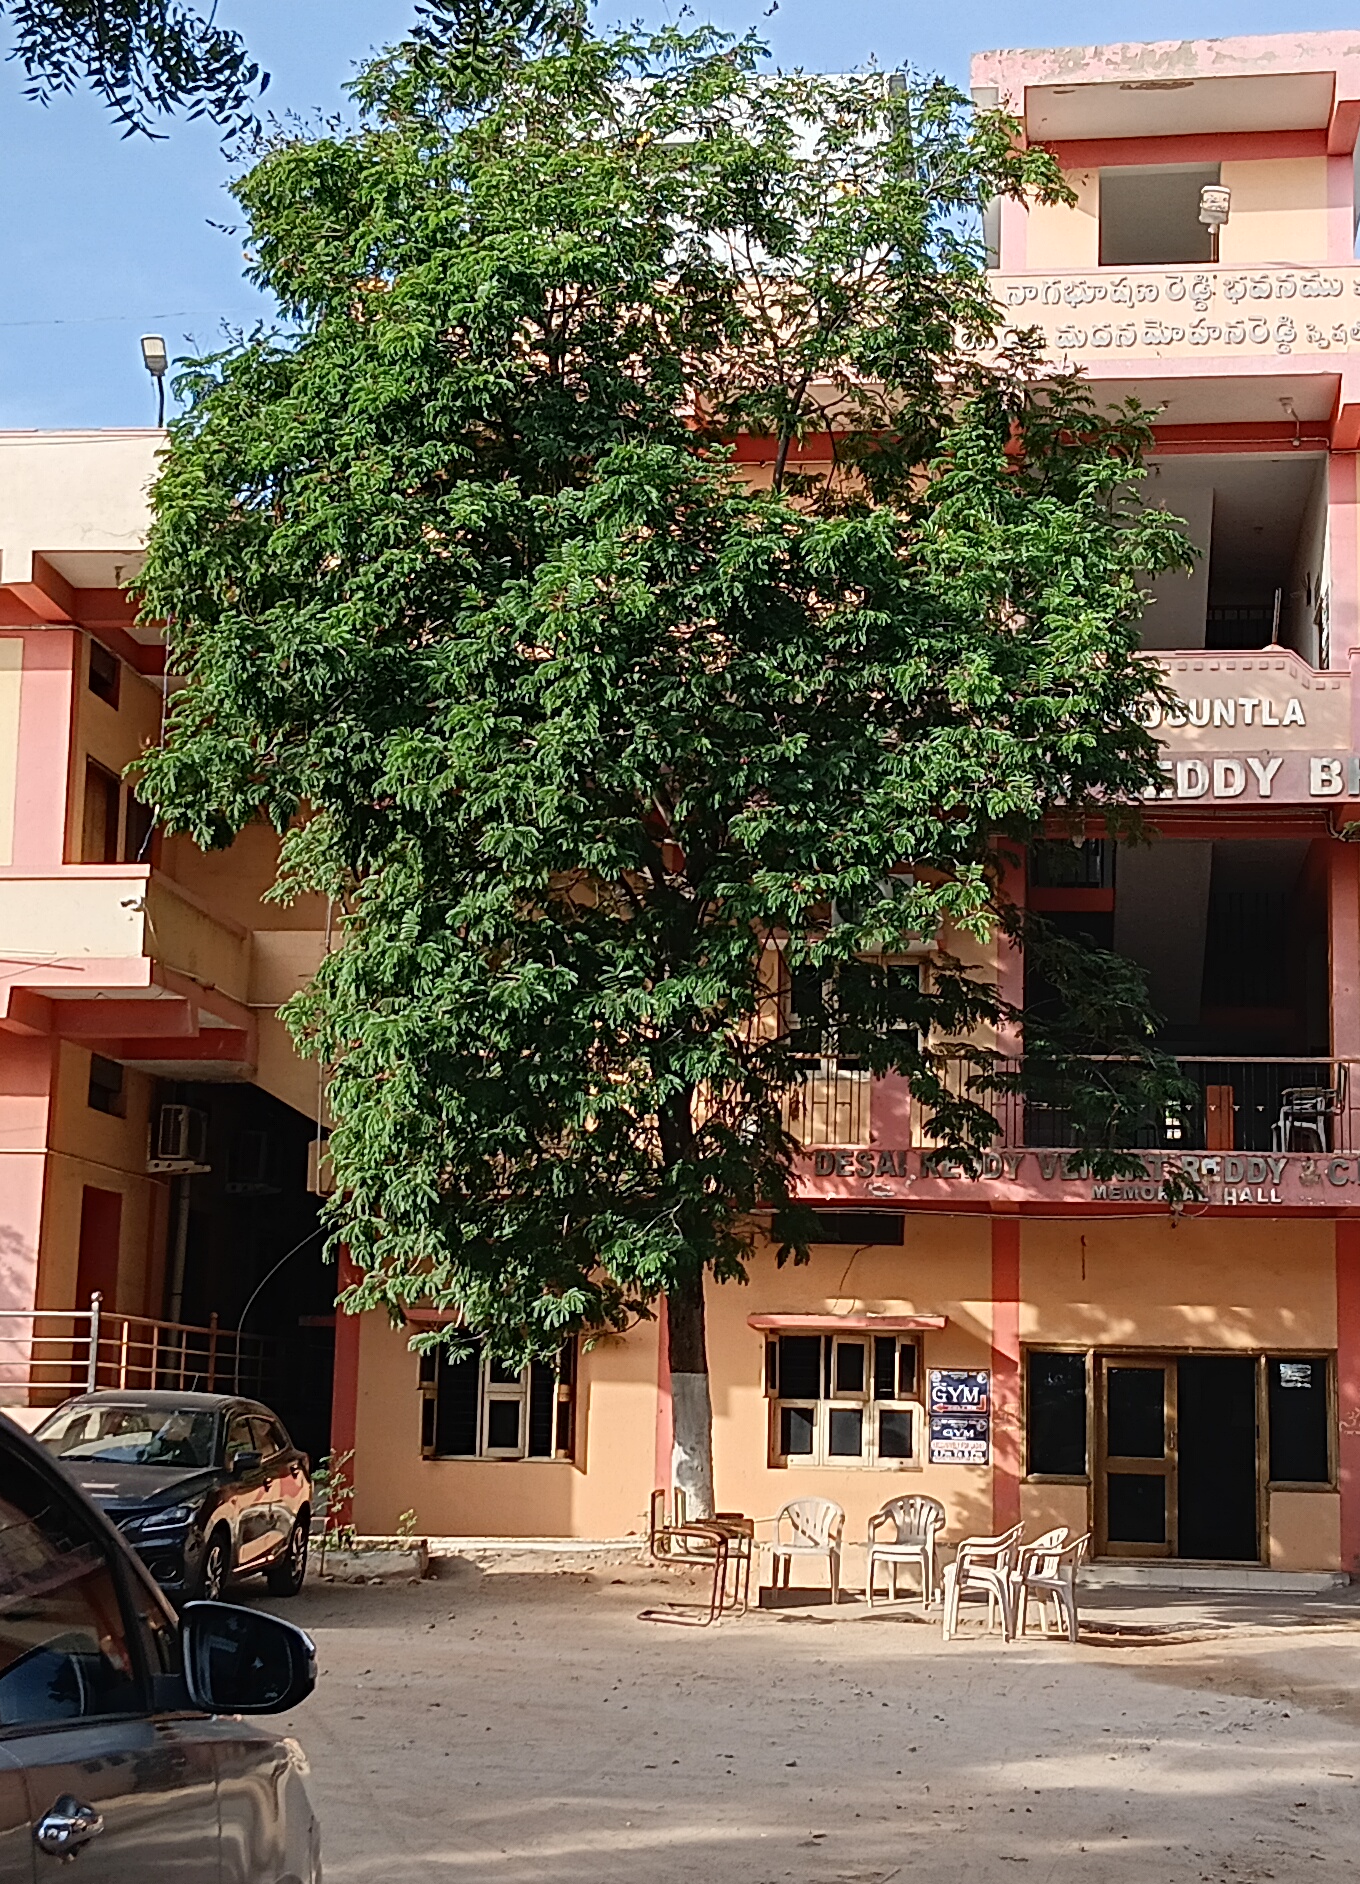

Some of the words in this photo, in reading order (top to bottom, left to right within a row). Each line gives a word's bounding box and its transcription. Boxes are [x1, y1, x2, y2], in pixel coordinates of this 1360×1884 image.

[1223, 271, 1344, 304] భవనము
[1143, 756, 1284, 799] EDDY
[815, 1150, 909, 1179] DESAI
[1091, 1185, 1210, 1202] MEMORAL
[1224, 1187, 1283, 1206] HALL
[932, 1384, 980, 1403] GYM
[942, 1428, 976, 1438] GYM
